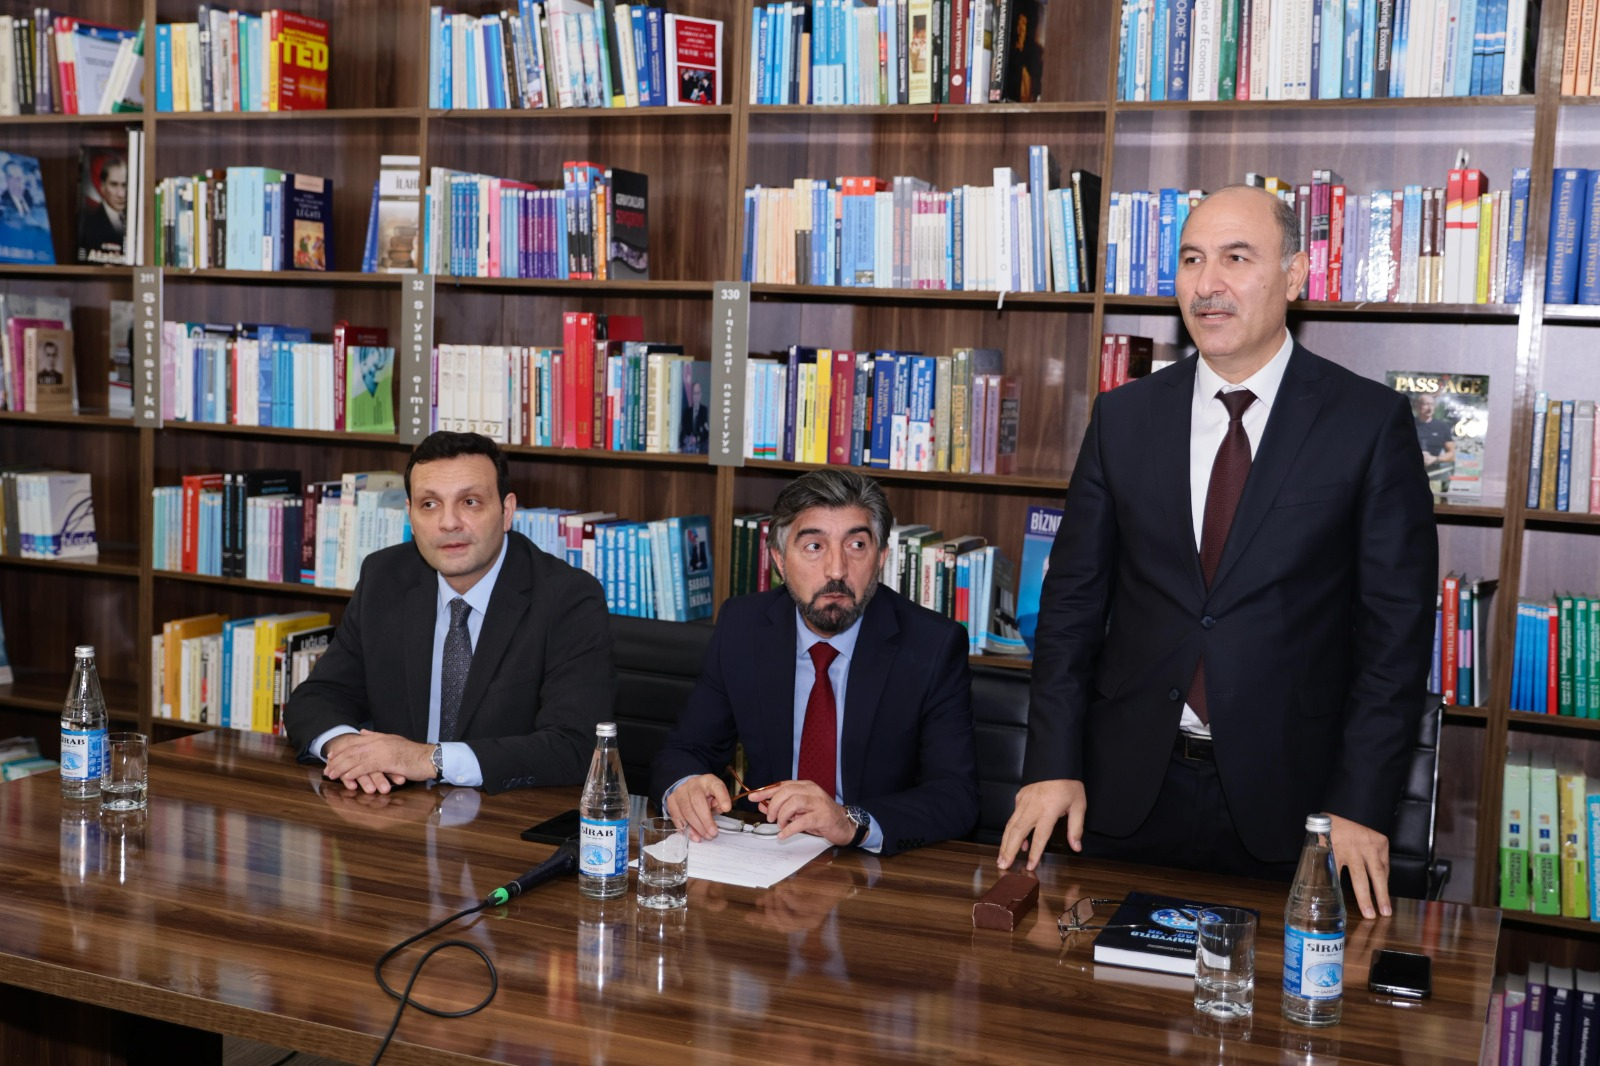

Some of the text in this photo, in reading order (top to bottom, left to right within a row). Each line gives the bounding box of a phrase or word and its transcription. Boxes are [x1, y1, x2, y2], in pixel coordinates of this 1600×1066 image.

[1156, 0, 1167, 82] ACROECONOMICS
[1200, 24, 1211, 35] of
[281, 38, 329, 71] TED
[995, 40, 1005, 82] DEMOCRACY
[1197, 38, 1211, 94] Economics
[1378, 29, 1391, 71] Economics
[1564, 218, 1577, 255] KURSU
[1551, 240, 1565, 286] İQTİSADİ
[412, 280, 424, 291] 32
[720, 288, 741, 300] 330
[413, 300, 424, 363] Siyasi
[142, 292, 156, 419] Statistika
[455, 423, 463, 432] 2
[484, 423, 492, 434] 4
[492, 424, 500, 434] 7
[581, 825, 615, 837] SİRAB
[1305, 940, 1346, 955] SİRAB
